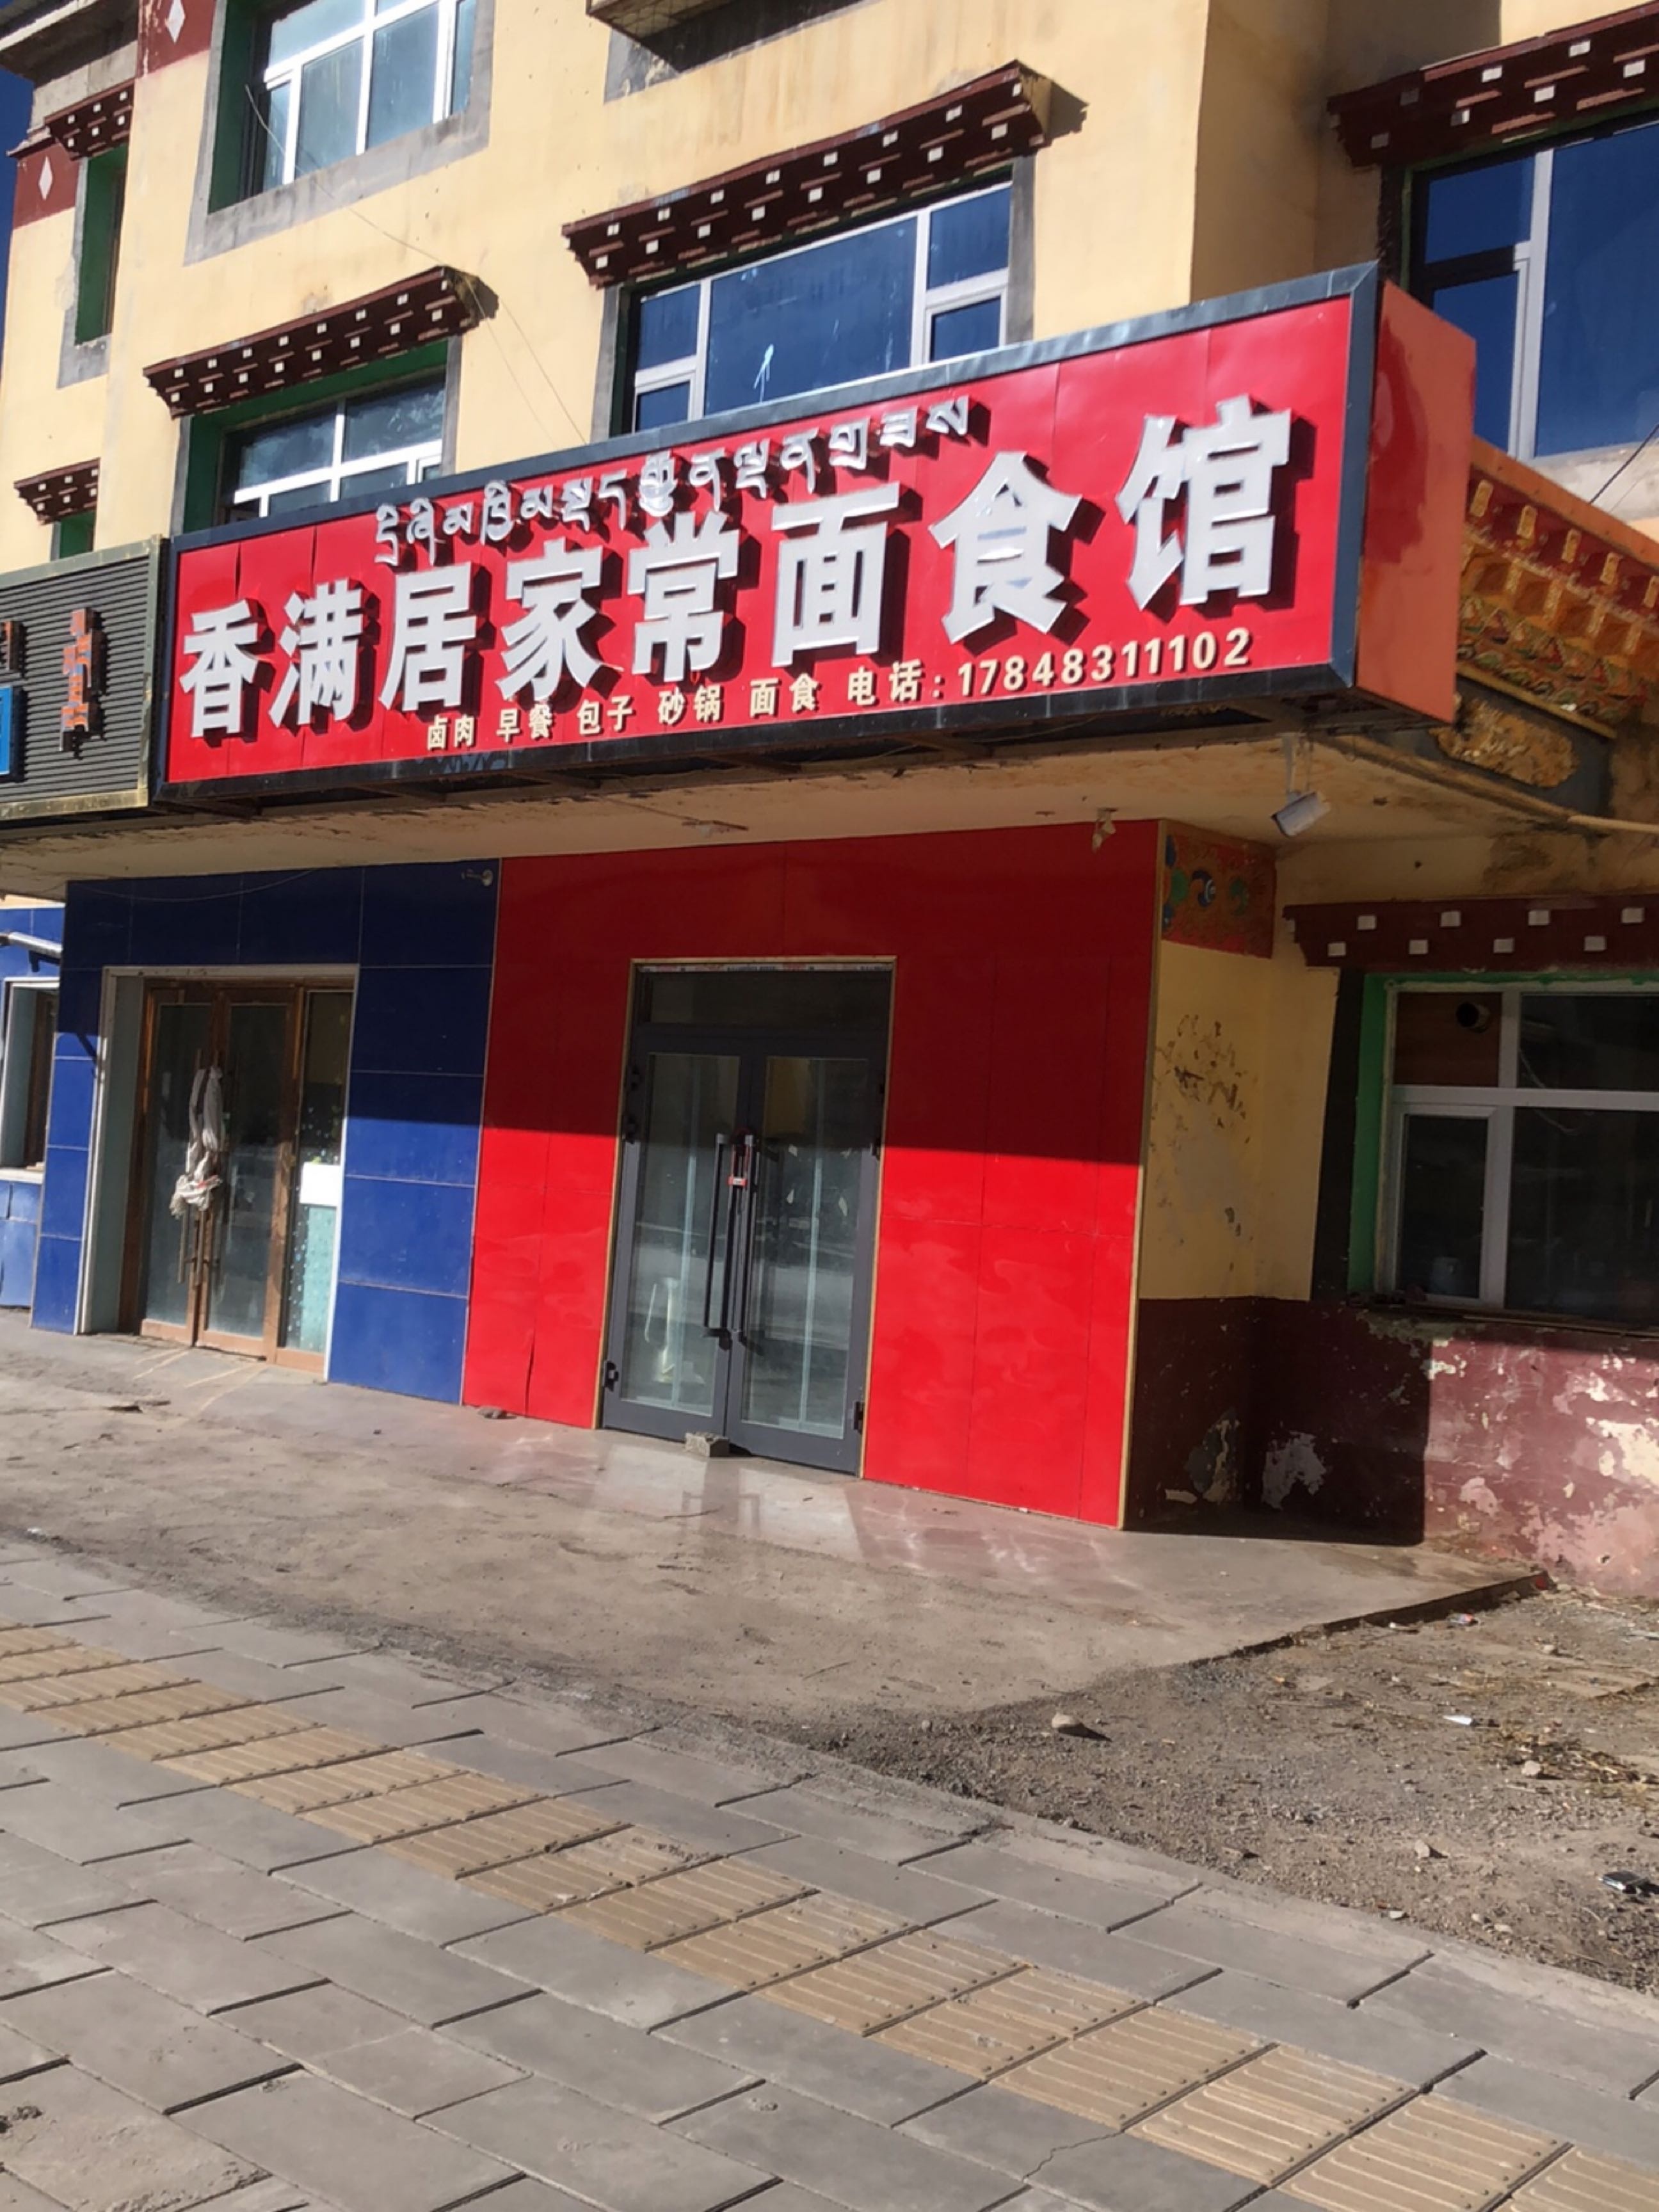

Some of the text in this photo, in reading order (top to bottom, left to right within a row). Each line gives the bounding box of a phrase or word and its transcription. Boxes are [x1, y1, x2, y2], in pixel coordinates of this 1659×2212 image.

[180, 395, 1291, 739] 香满居家常面食馆
[426, 714, 475, 750] 卤肉
[496, 703, 553, 742] 早餐
[577, 695, 633, 735] 包子
[657, 684, 721, 725] 砂锅
[749, 673, 819, 717] 面食
